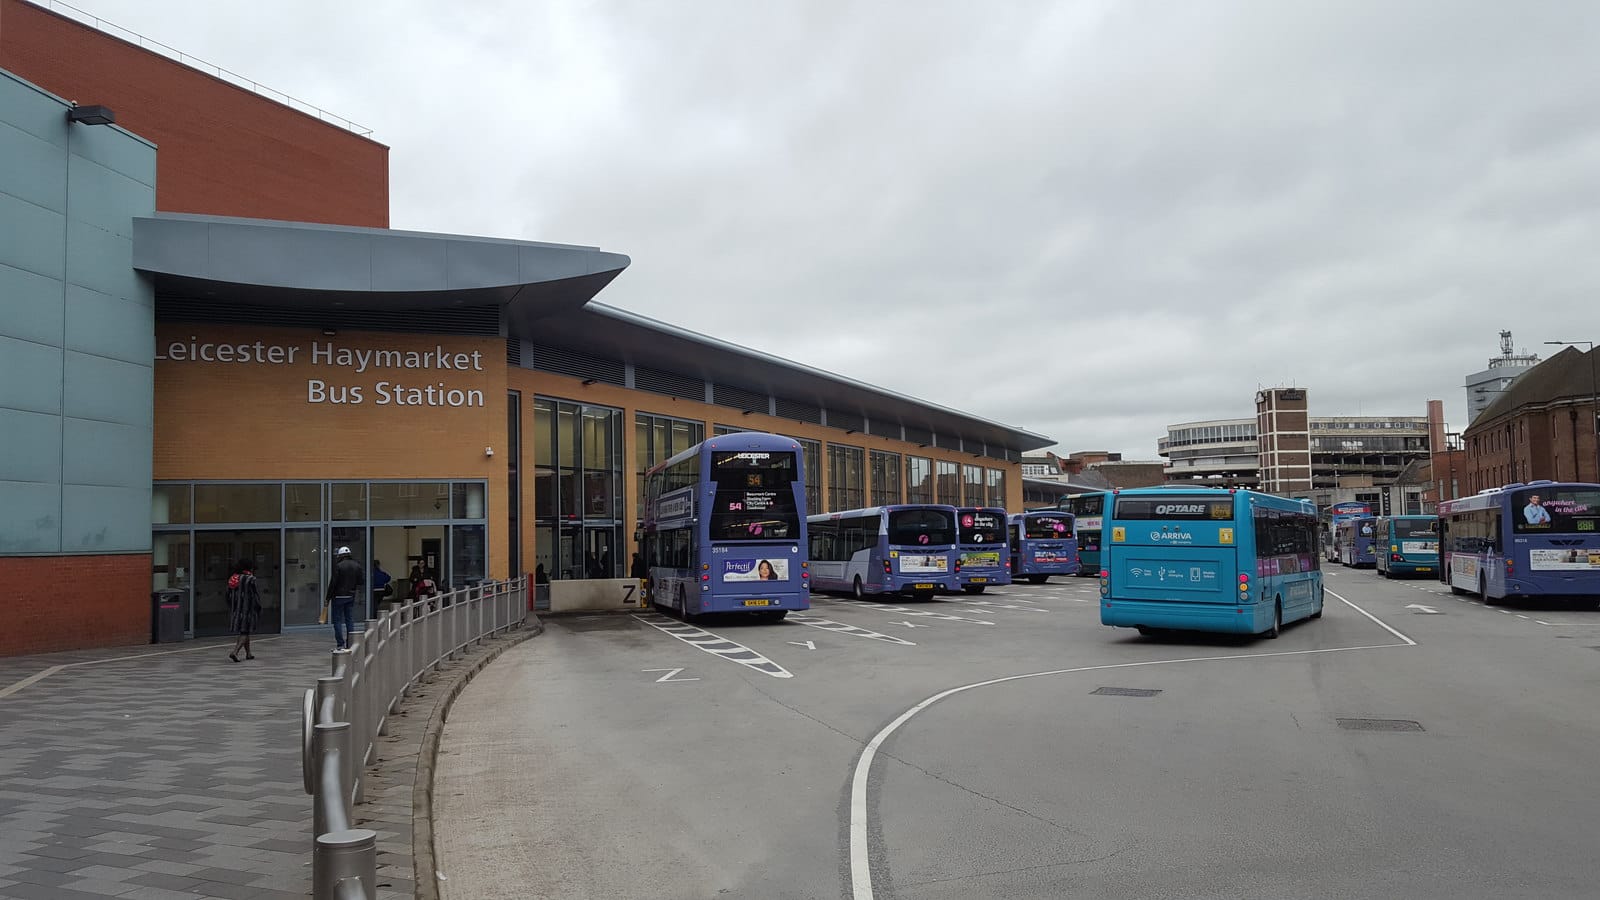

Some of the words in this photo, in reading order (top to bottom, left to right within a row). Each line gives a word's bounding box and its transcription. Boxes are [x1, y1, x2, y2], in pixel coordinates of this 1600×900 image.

[311, 341, 483, 373] Haymarket
[308, 379, 363, 404] Bus
[375, 381, 484, 407] Station
[737, 452, 770, 460] LEICESTER
[747, 473, 761, 487] 54
[729, 502, 742, 511] 54
[1542, 499, 1576, 507] anywhere
[1574, 503, 1588, 513] city
[1155, 504, 1206, 515] OPTARE
[1161, 532, 1192, 540] ARRIVA
[726, 561, 751, 571] Perfectil
[623, 585, 636, 604] Z
[786, 640, 817, 650] Y
[641, 667, 701, 683] Z
